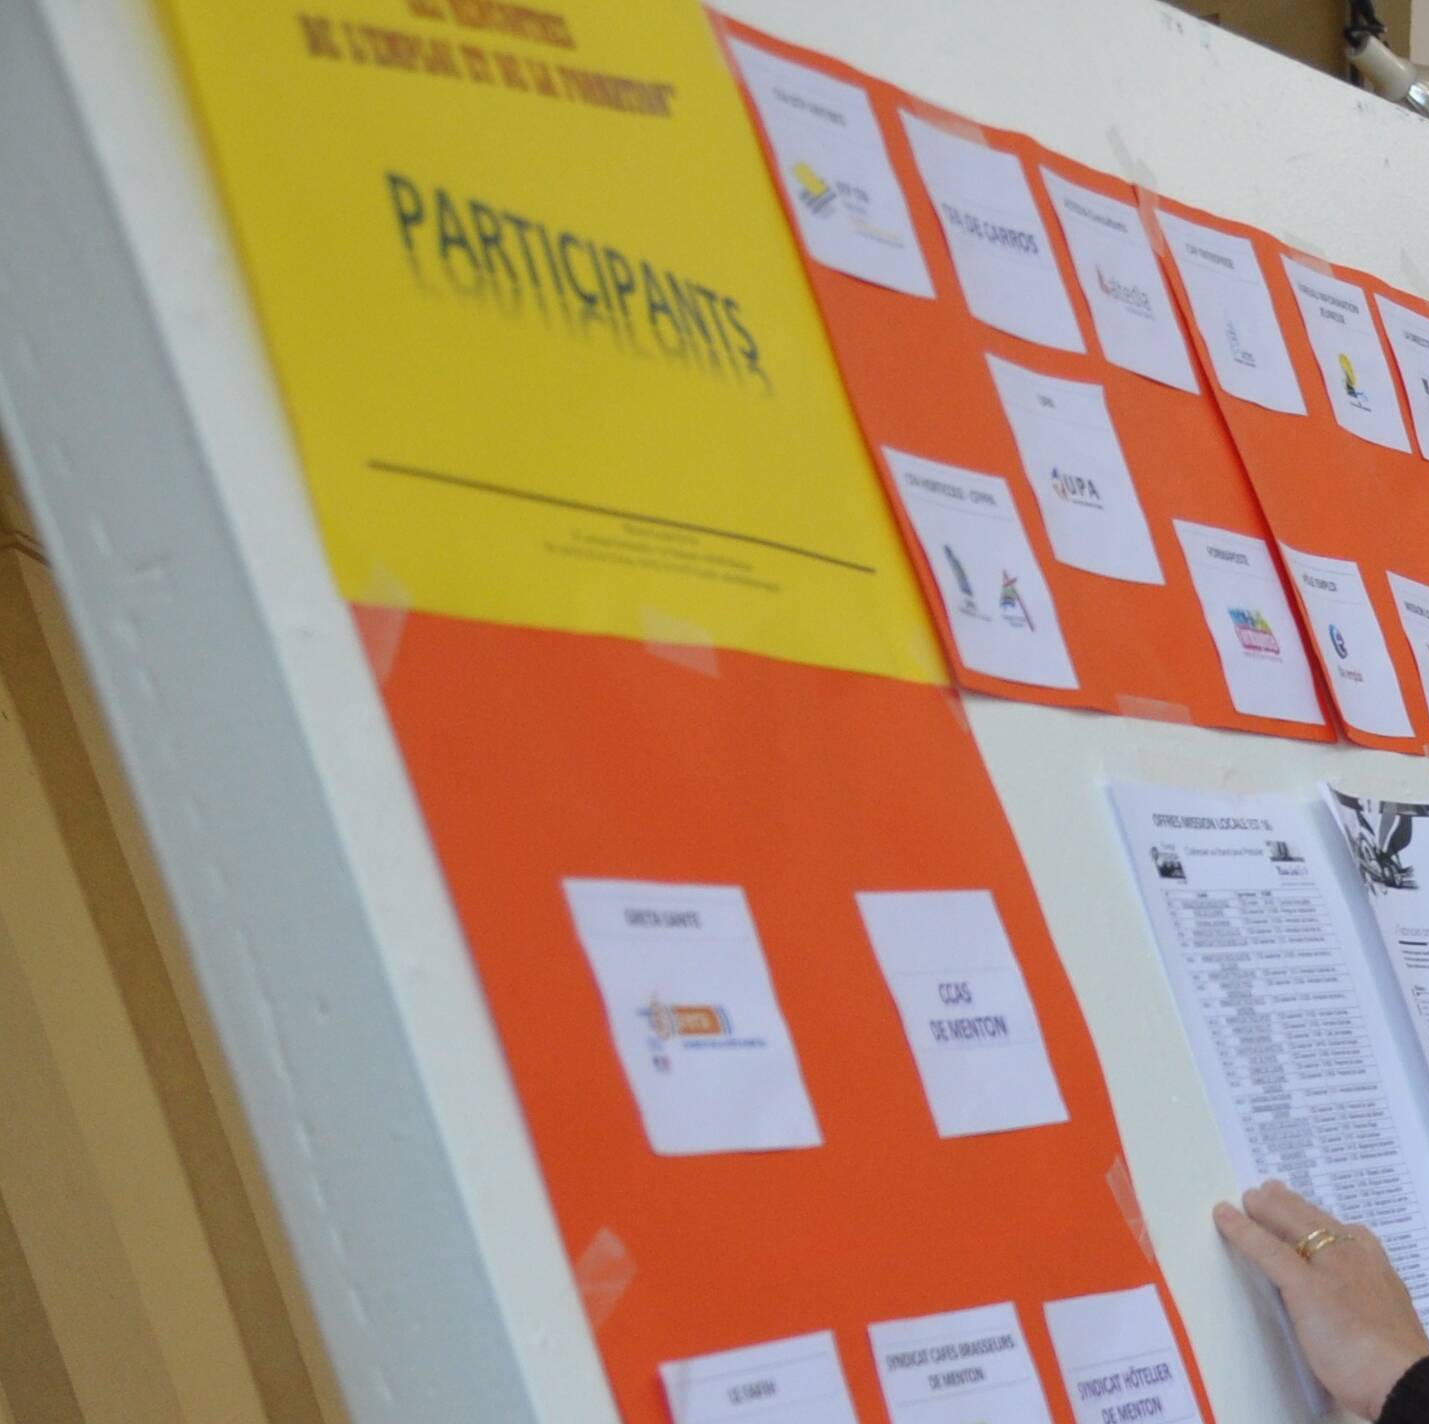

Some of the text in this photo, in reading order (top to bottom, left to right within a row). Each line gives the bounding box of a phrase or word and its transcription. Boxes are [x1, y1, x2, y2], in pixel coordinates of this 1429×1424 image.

[983, 221, 1039, 254] CARROS
[384, 170, 761, 363] PARTICIPANTS
[1063, 473, 1101, 500] UPA
[937, 980, 974, 1005] CCAS
[929, 1013, 1009, 1042] DE MENTON
[885, 1348, 929, 1373] SYNDICAT
[928, 1366, 986, 1391] DE MENTON
[1076, 1371, 1125, 1402] SYNDICAT
[1121, 1396, 1164, 1424] MENTON
